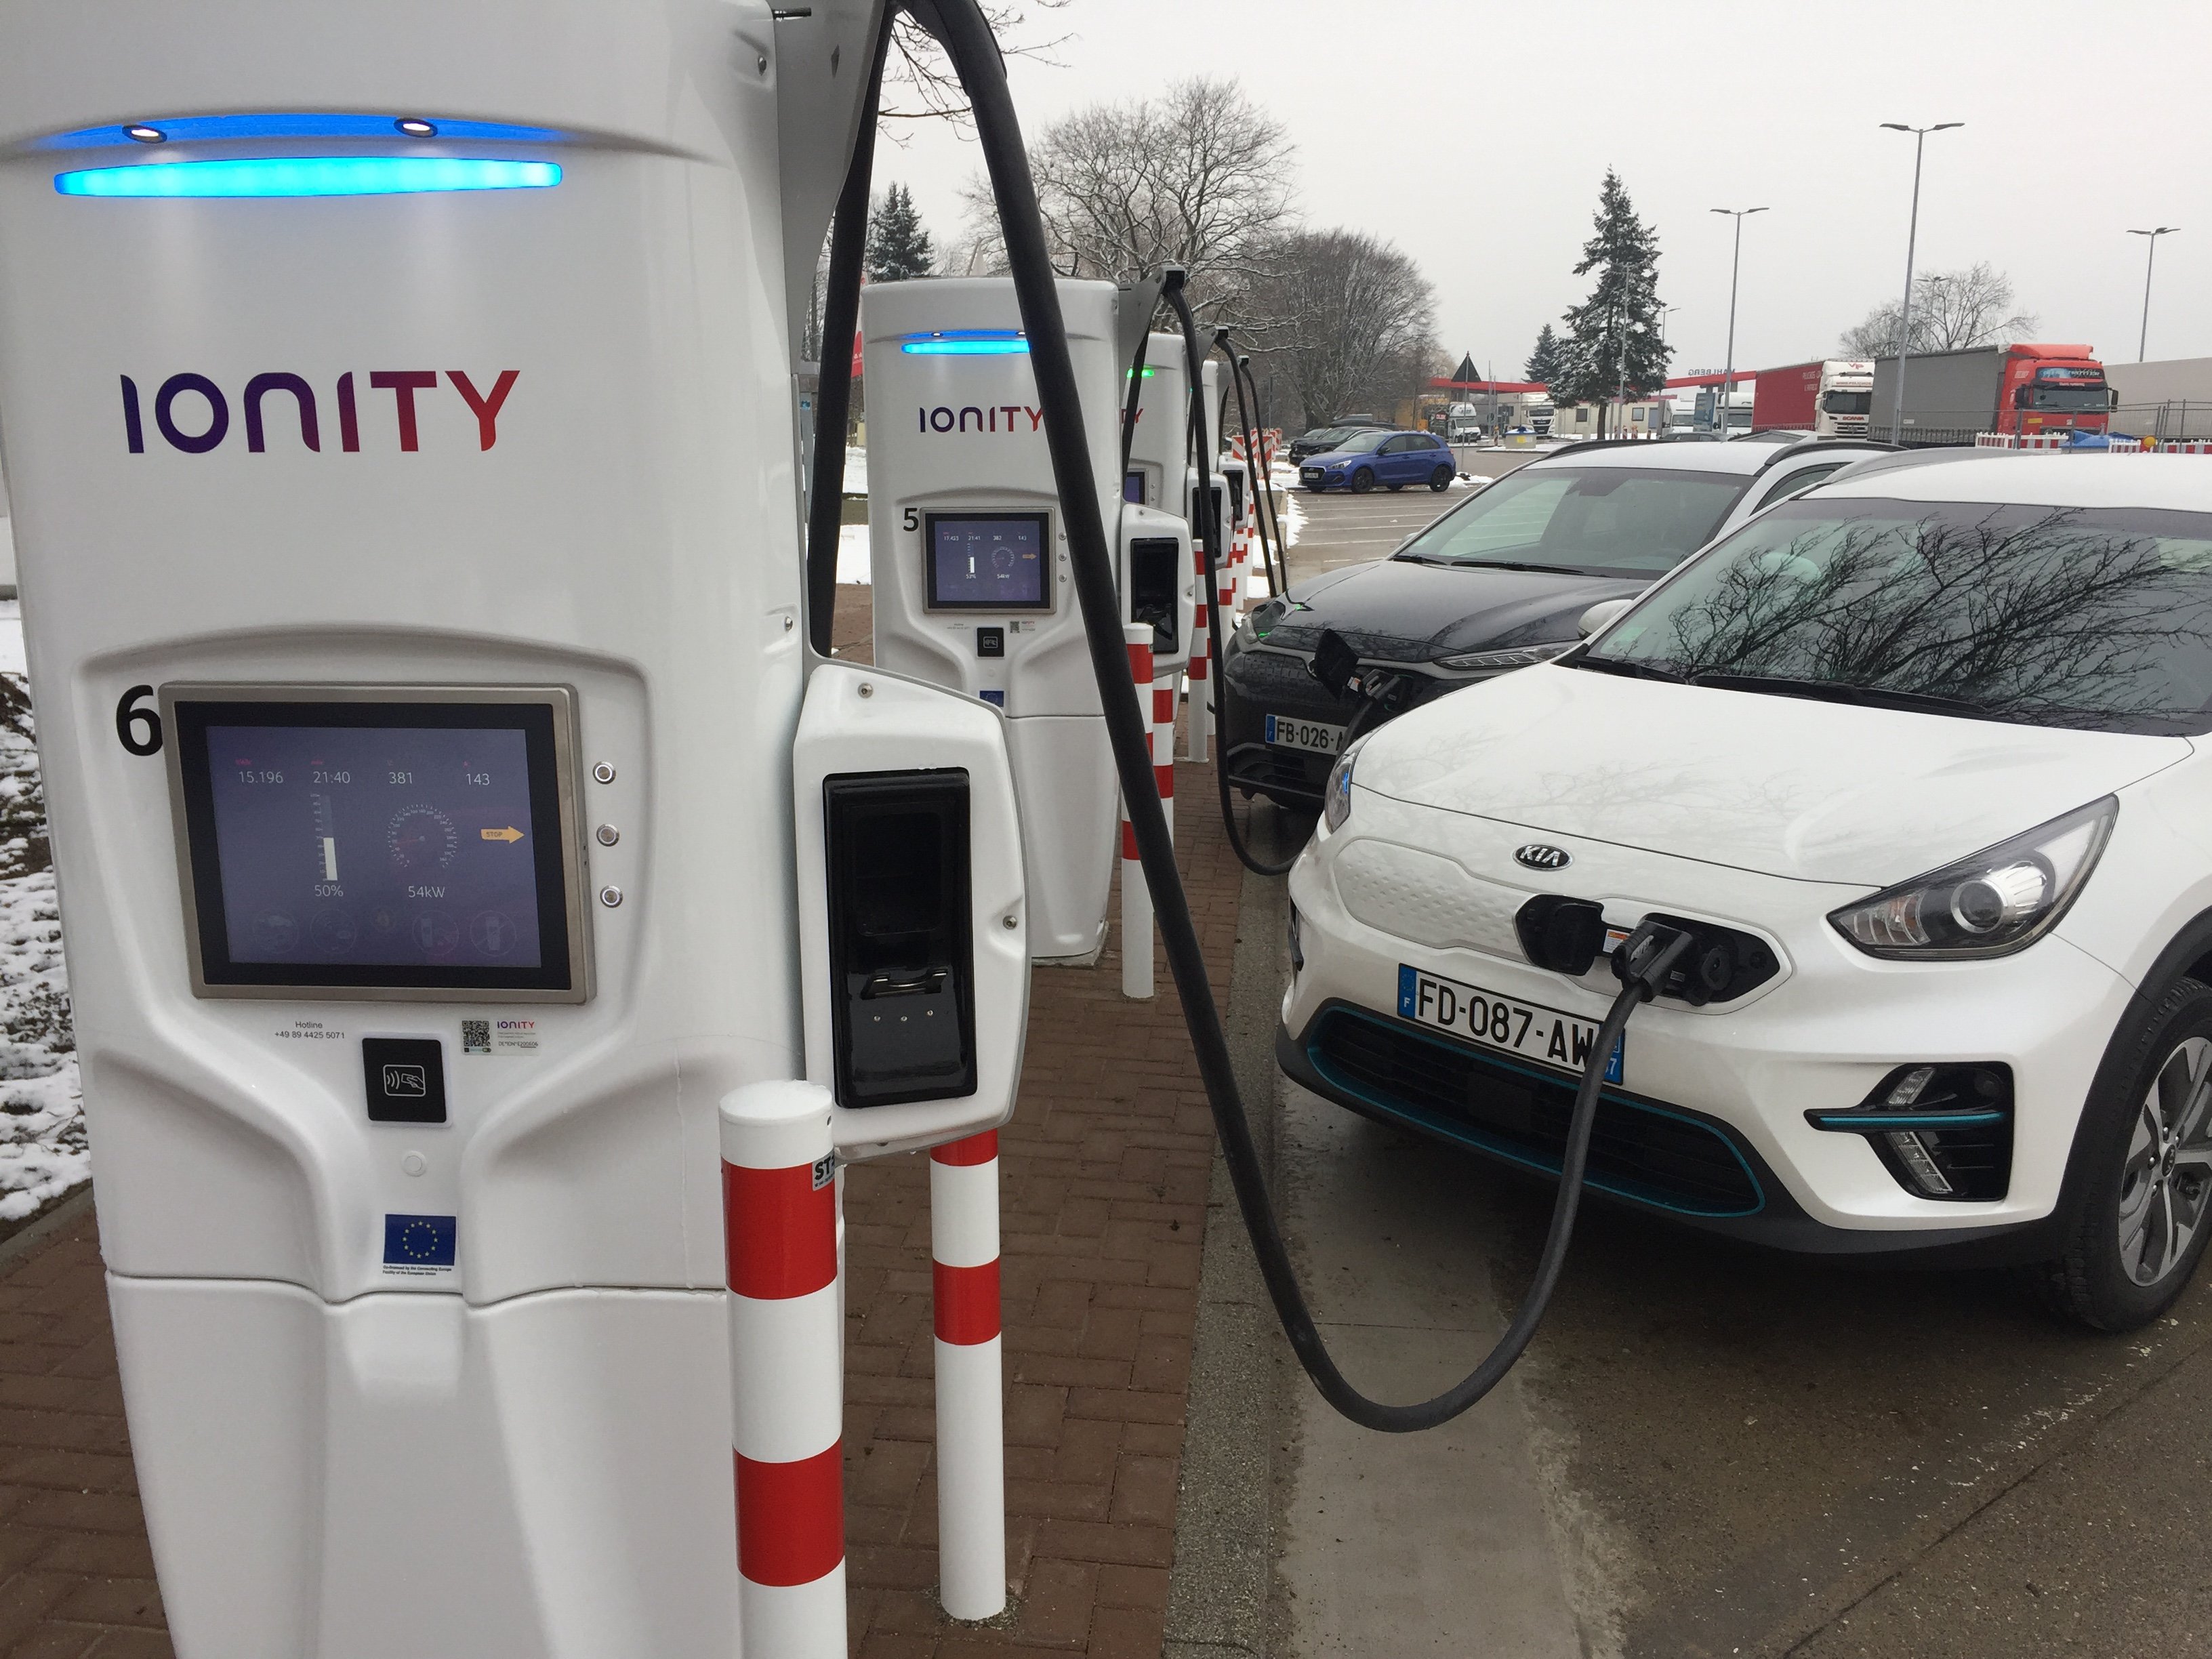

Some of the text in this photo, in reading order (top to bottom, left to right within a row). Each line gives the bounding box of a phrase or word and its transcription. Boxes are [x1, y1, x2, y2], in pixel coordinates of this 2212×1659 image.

[120, 370, 520, 453] IONITY
[920, 406, 1043, 432] IONITY
[903, 508, 919, 532] 5
[116, 684, 164, 756] 6
[239, 771, 490, 785] 15.196 21:40 381 143
[1519, 845, 1560, 867] KIA
[314, 884, 445, 898] 50% 54kW
[1404, 998, 1411, 1008] F
[497, 1021, 535, 1029] IONITY
[1418, 978, 1594, 1065] FD-087-AW
